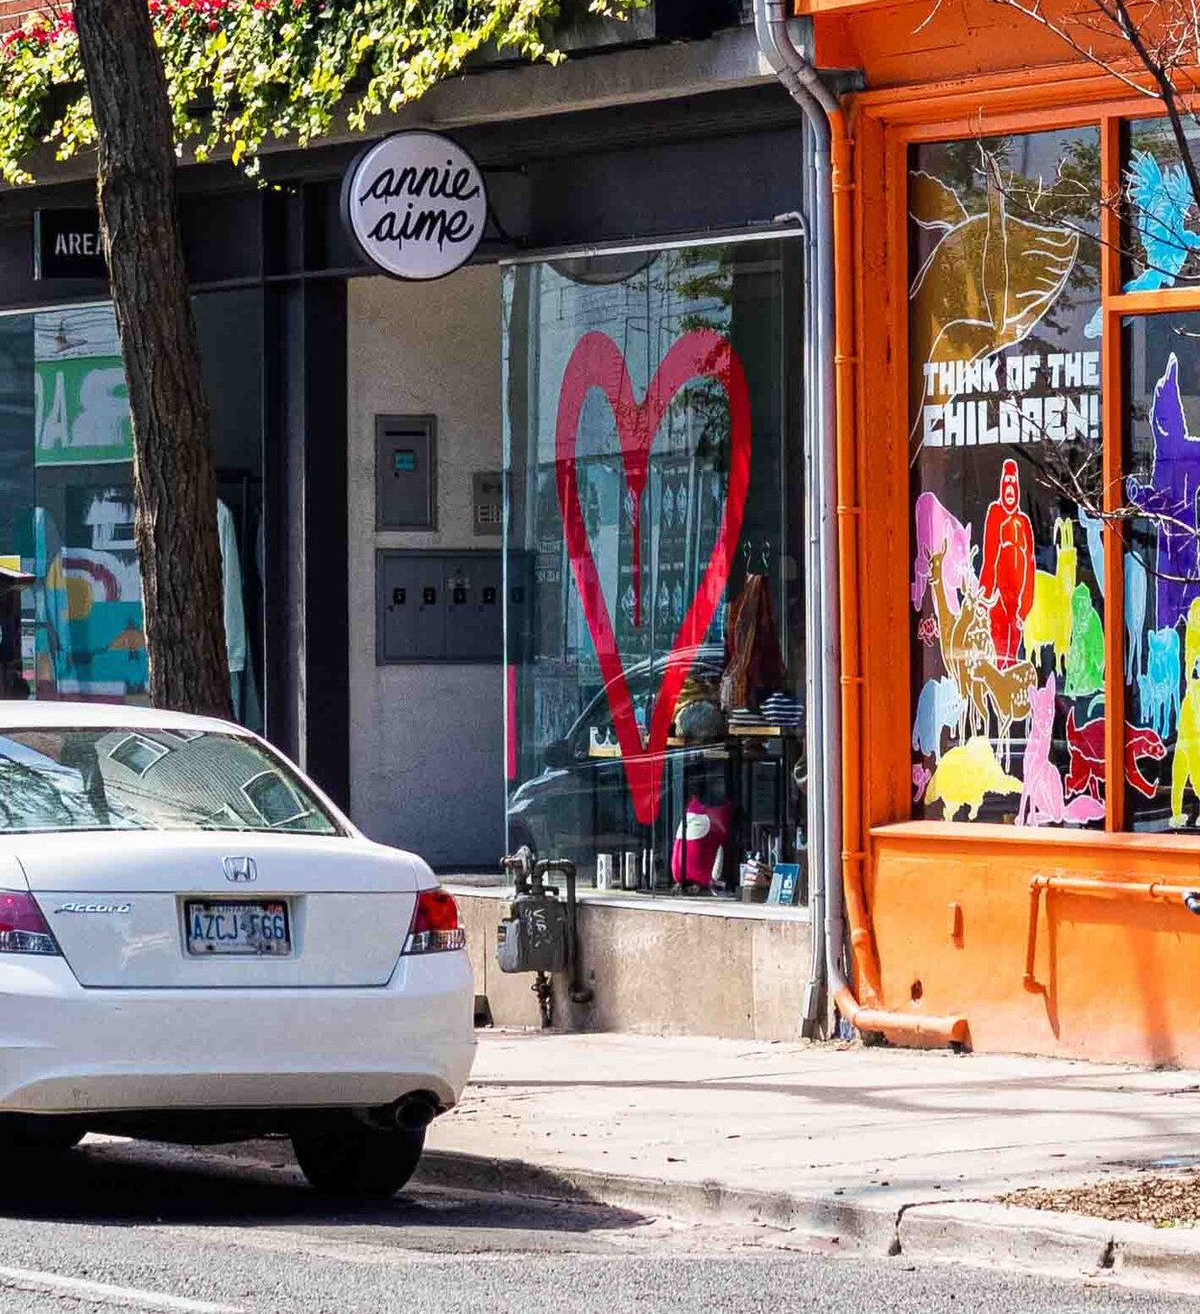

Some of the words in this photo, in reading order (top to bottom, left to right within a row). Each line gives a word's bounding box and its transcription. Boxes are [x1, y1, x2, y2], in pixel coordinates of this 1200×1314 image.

[359, 159, 480, 206] annie
[367, 202, 475, 253] aime
[923, 356, 1001, 396] THINK
[1006, 354, 1041, 391] OF
[1047, 351, 1101, 389] THE
[923, 394, 1100, 448] CHILDREN!
